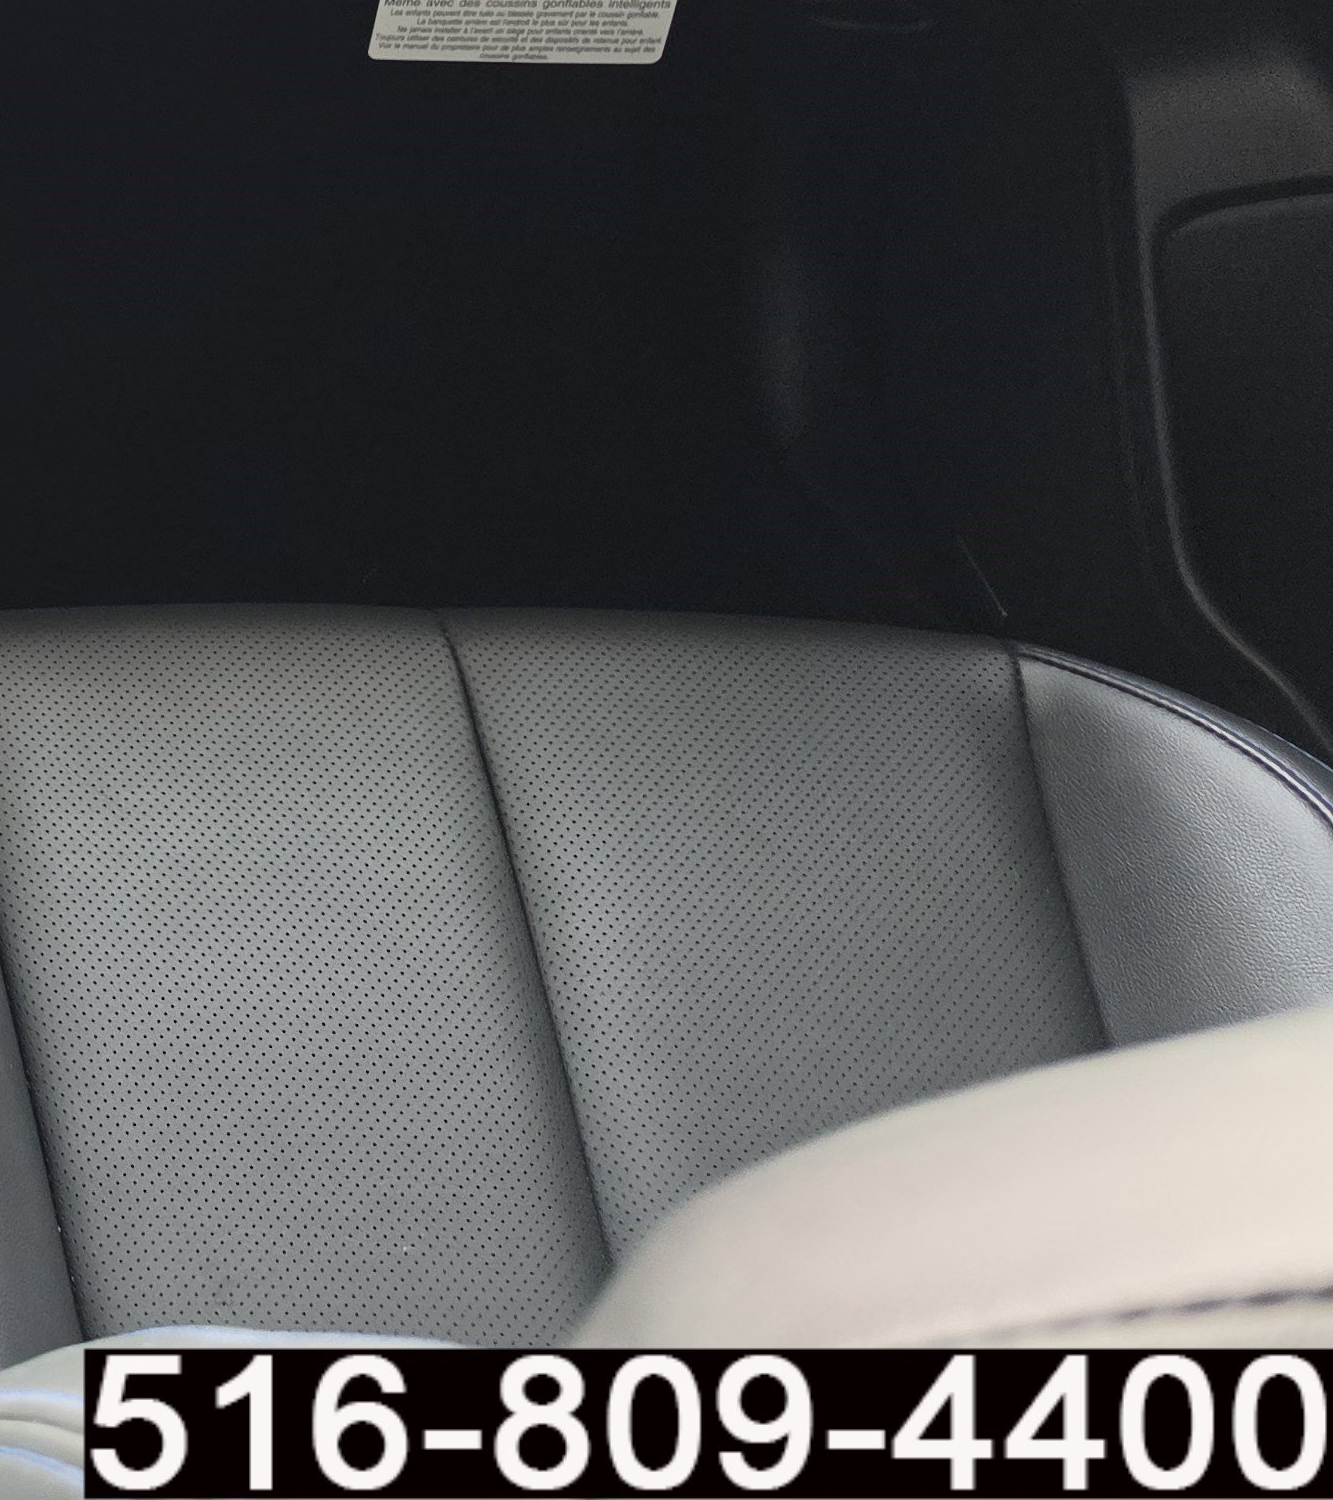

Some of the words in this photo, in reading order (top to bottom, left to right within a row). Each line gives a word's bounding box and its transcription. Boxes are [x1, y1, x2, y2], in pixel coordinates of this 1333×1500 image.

[485, 0, 538, 9] coussins
[542, 0, 604, 10] gonflables
[607, 0, 671, 10] intelligents
